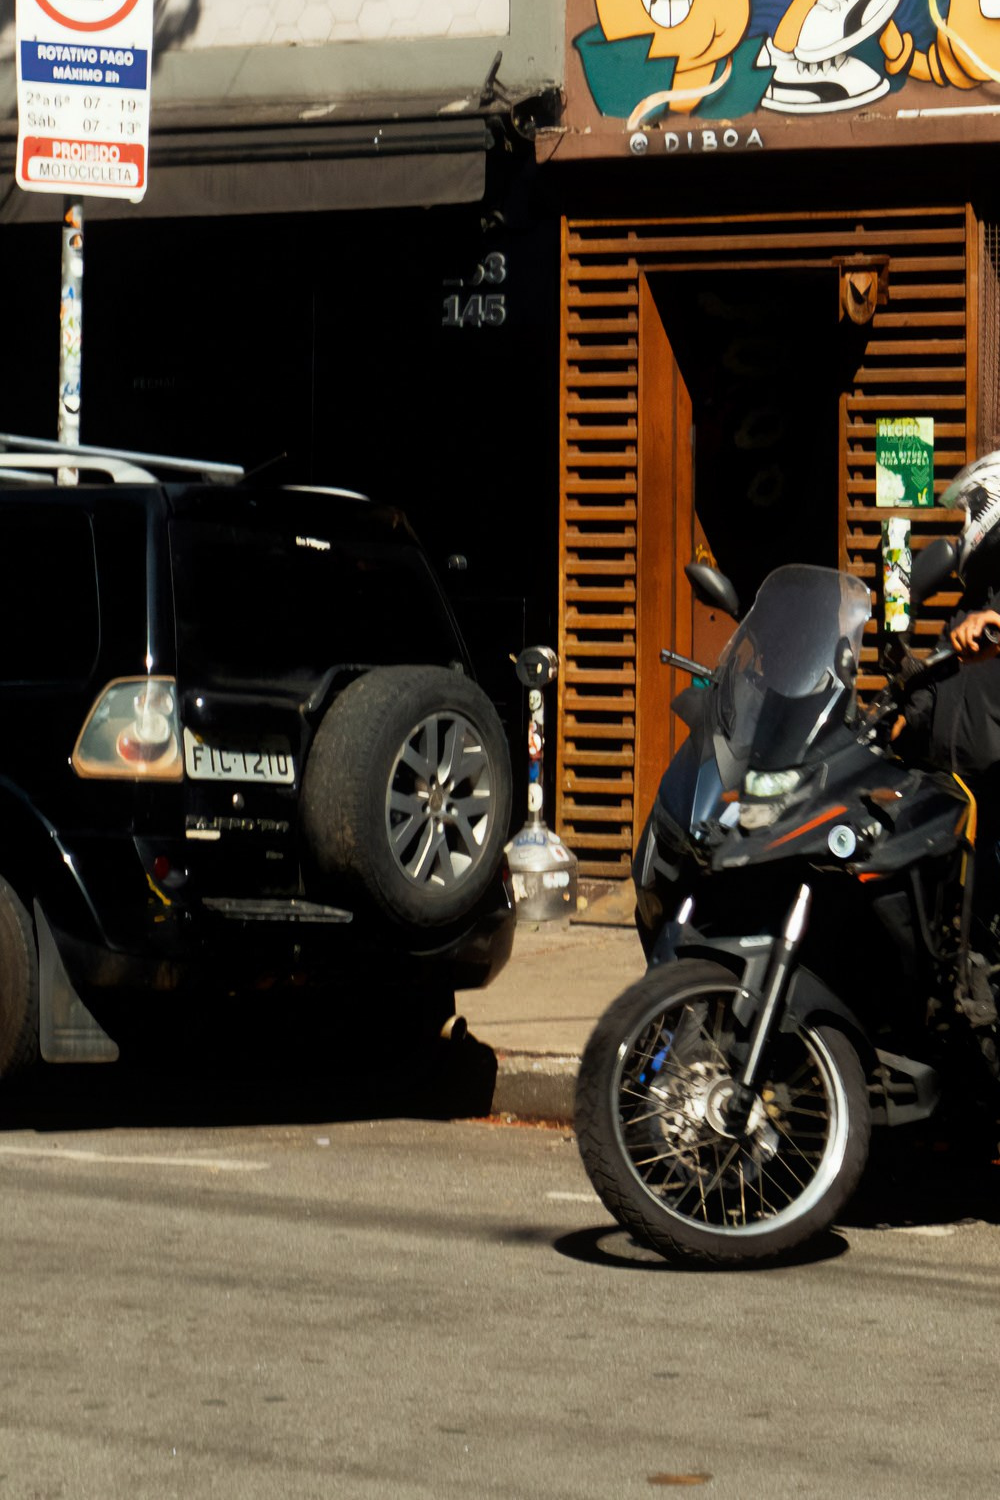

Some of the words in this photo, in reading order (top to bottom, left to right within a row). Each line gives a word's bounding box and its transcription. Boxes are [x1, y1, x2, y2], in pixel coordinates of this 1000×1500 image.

[37, 44, 98, 64] ROTATIVO
[100, 49, 134, 67] PAGO
[53, 64, 103, 82] MÁXIMO
[83, 95, 101, 109] 07
[82, 118, 100, 132] 07
[665, 127, 764, 153] DIBOA
[52, 141, 121, 163] PROIBIDO
[39, 162, 132, 182] MOTOCICLETA
[441, 293, 507, 329] 145
